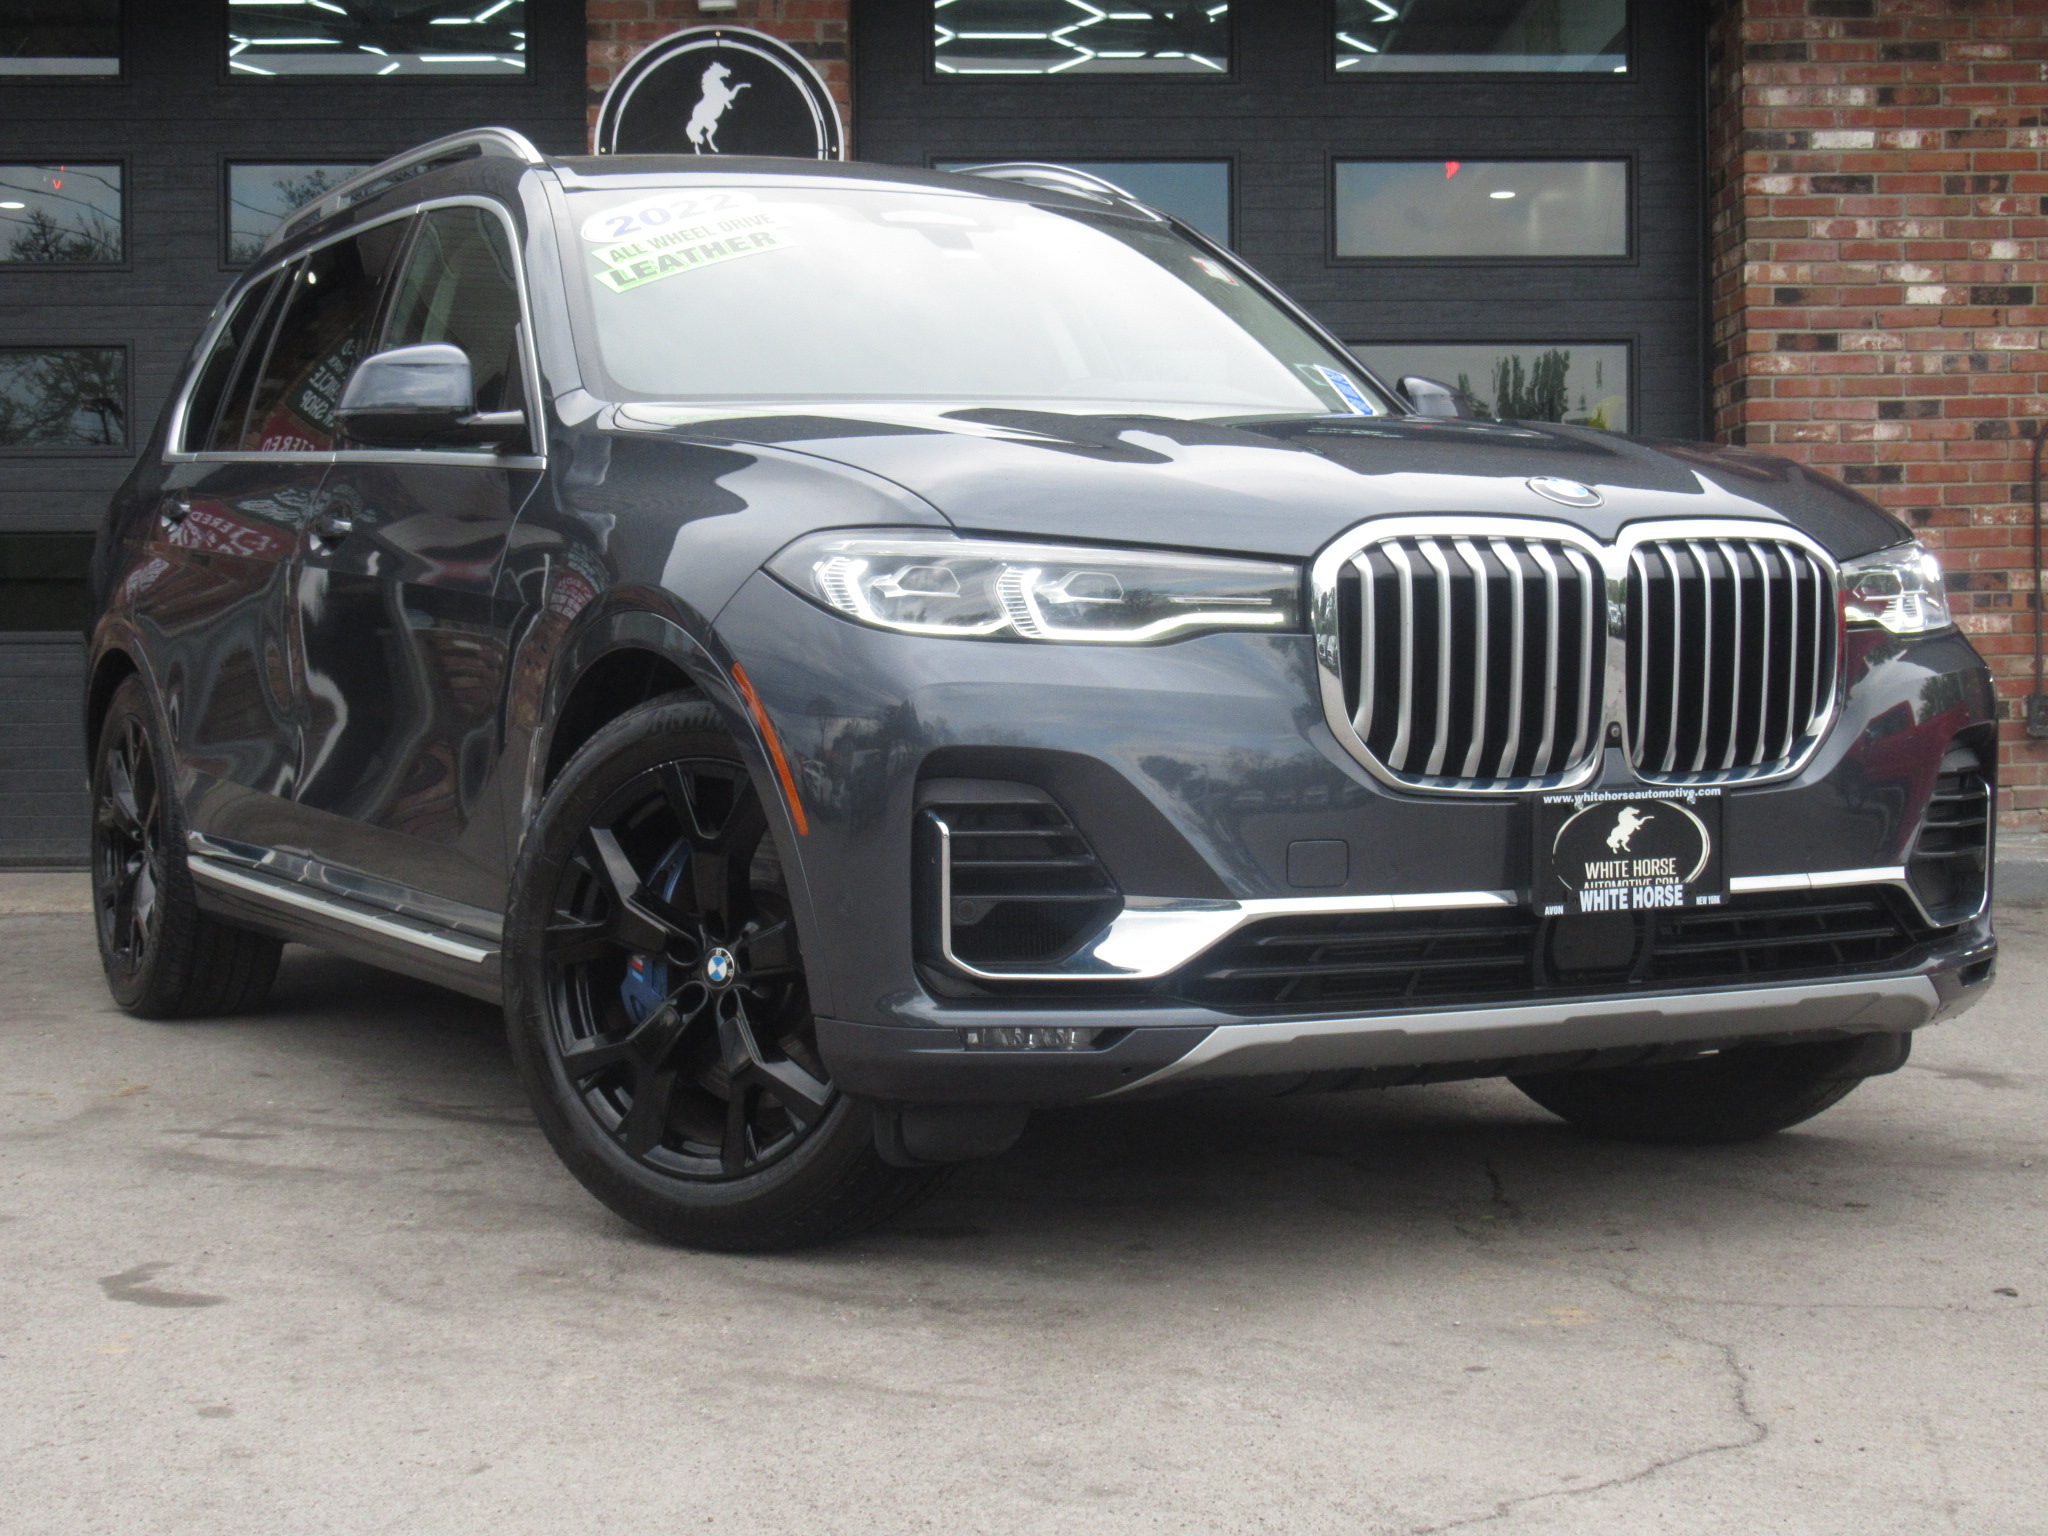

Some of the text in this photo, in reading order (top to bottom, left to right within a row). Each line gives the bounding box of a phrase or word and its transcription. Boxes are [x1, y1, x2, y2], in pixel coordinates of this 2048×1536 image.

[604, 193, 740, 238] 2022
[609, 213, 775, 262] ALL WHEEL DRIVE
[609, 231, 776, 286] LEATHER
[1543, 788, 1721, 803] www.whitehorseautomotive.com
[1585, 857, 1677, 880] WHITE HORSE
[1544, 905, 1564, 916] AVON
[1579, 887, 1629, 912] WHITE
[1632, 884, 1683, 909] HORSE
